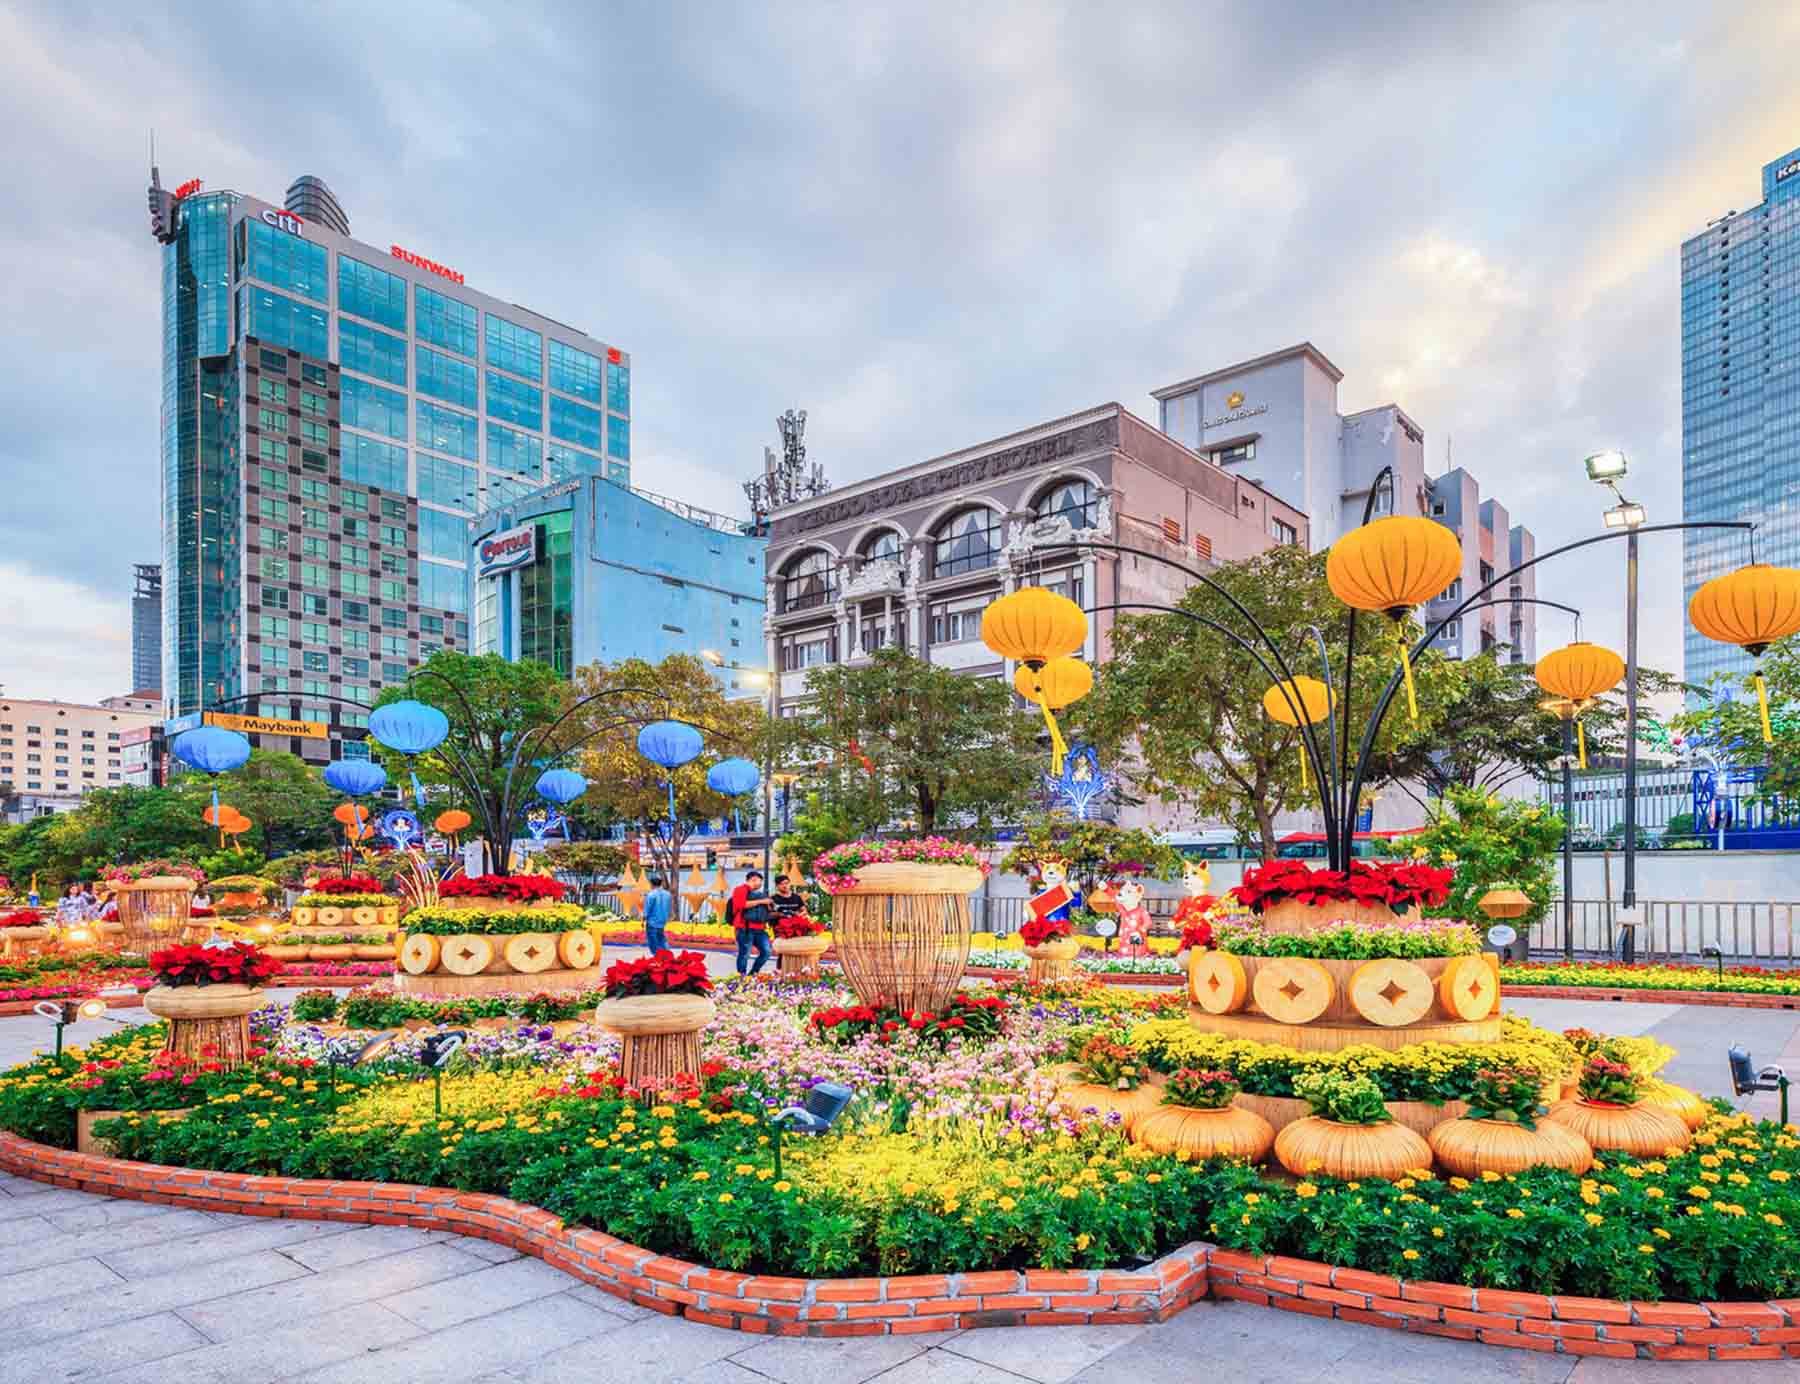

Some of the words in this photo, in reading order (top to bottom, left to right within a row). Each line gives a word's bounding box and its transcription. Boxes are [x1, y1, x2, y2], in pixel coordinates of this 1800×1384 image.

[262, 209, 304, 236] citi
[391, 245, 465, 285] SUNWAH
[991, 436, 1073, 476] HOTEL
[243, 719, 312, 735] Maybank
